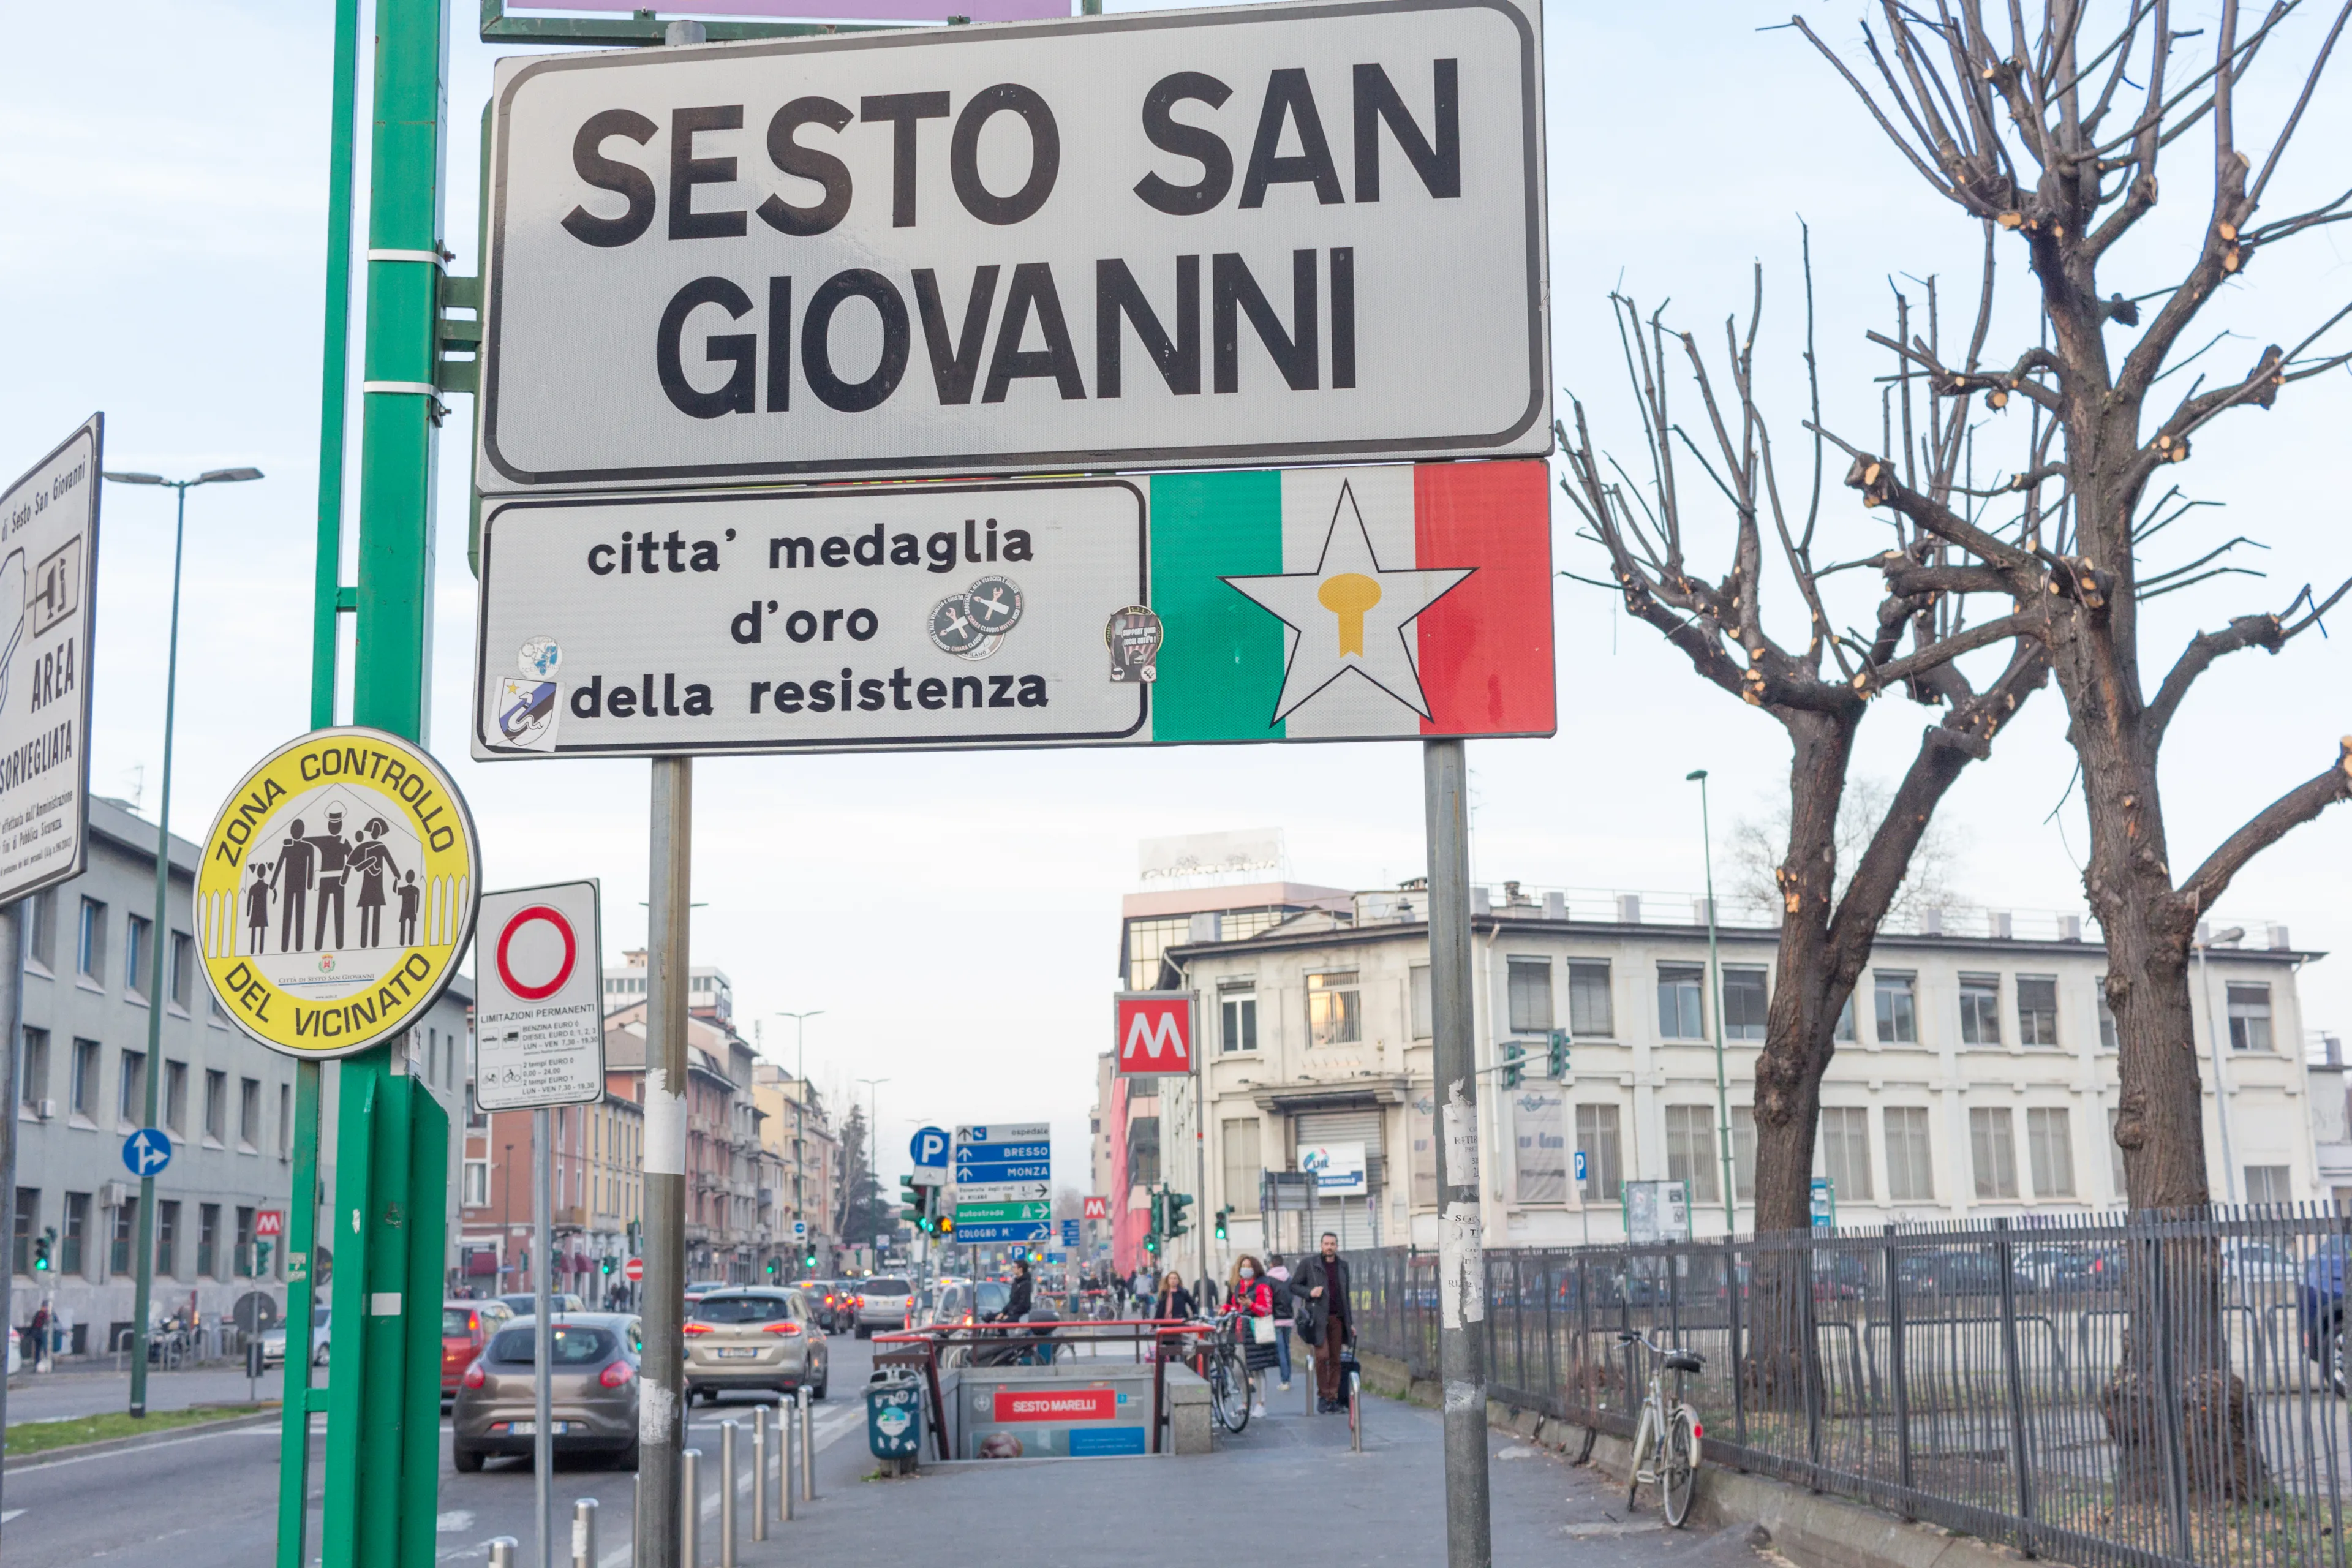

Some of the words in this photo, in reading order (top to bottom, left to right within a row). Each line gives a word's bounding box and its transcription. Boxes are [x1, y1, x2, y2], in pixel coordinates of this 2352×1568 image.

[560, 83, 1061, 248] SESTO
[1132, 58, 1461, 216] SAN
[657, 246, 1357, 420] GIOVANNI
[2, 517, 8, 542] di
[12, 502, 31, 534] Sesto
[34, 491, 48, 515] San
[53, 454, 86, 501] Giovanni
[769, 518, 1035, 574] medaglia
[731, 600, 879, 644] d'oro
[968, 633, 984, 648] CLAUDIO
[31, 636, 74, 714] AREA
[570, 673, 715, 719] della
[750, 667, 1049, 714] resistenza
[0, 718, 72, 795] SORVEGLIATA
[215, 778, 287, 868] ZONA
[299, 747, 455, 854] CONTROLLO
[224, 961, 273, 1023] DEL
[295, 952, 431, 1038] VICINATO
[481, 1010, 533, 1023] LIMITAZIONI
[536, 1003, 595, 1018] PERMANENTI
[522, 1023, 552, 1033] BENZINA
[522, 1032, 547, 1041] DIESEL
[549, 1030, 568, 1038] EURO
[1123, 1011, 1187, 1059] M
[523, 1041, 537, 1050] LUN
[544, 1039, 559, 1048] VEN
[529, 1060, 547, 1069] tempi
[1011, 1127, 1049, 1136] ospedale
[921, 1134, 944, 1163] P
[1003, 1147, 1048, 1158] BRESSO
[1007, 1166, 1049, 1177] MONZA
[1576, 1155, 1584, 1178] P
[1085, 1199, 1106, 1215] M
[256, 1215, 280, 1232] M
[959, 1228, 997, 1238] COLOGNO
[1014, 1246, 1023, 1258] P
[1012, 1400, 1050, 1412] SESTO
[1050, 1398, 1096, 1412] MARELLI
